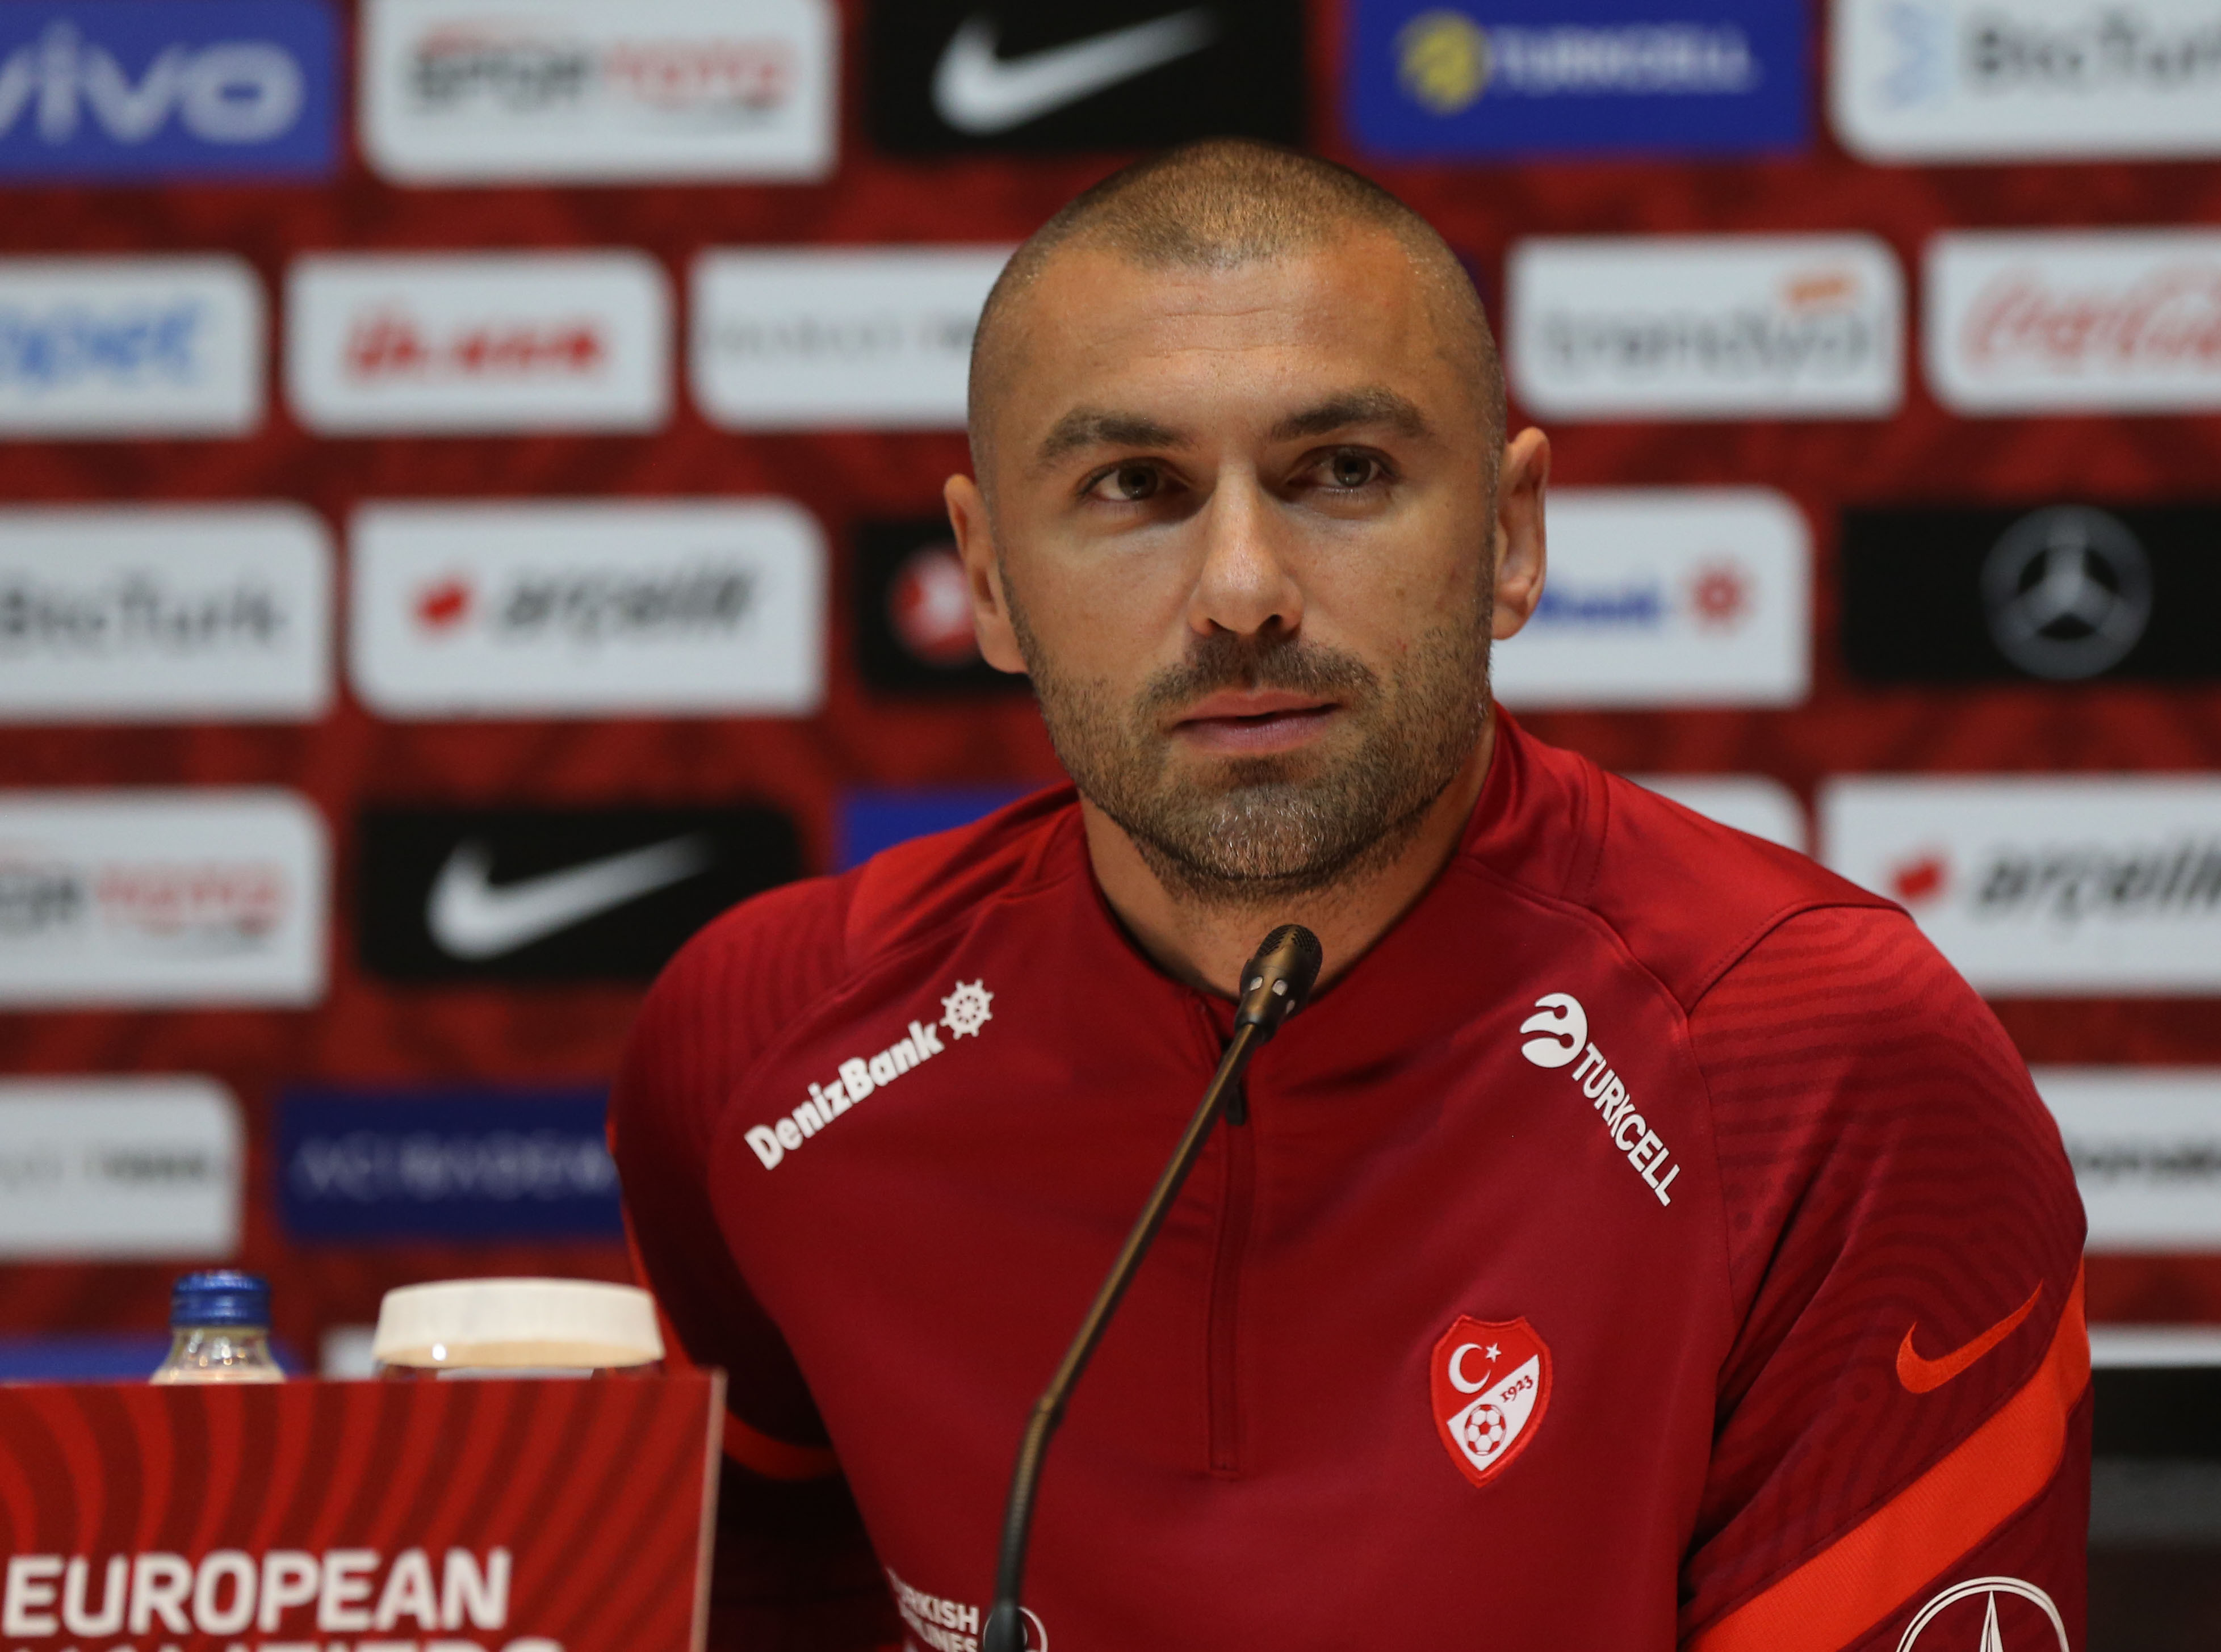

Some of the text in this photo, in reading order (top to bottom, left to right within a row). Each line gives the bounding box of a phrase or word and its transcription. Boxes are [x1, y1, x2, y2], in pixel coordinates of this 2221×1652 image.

[744, 1020, 945, 1171] DenizBank
[1572, 1042, 1681, 1207] TURKCELL
[1499, 1375, 1533, 1403] 1923
[3, 1547, 512, 1637] EUROPEAN
